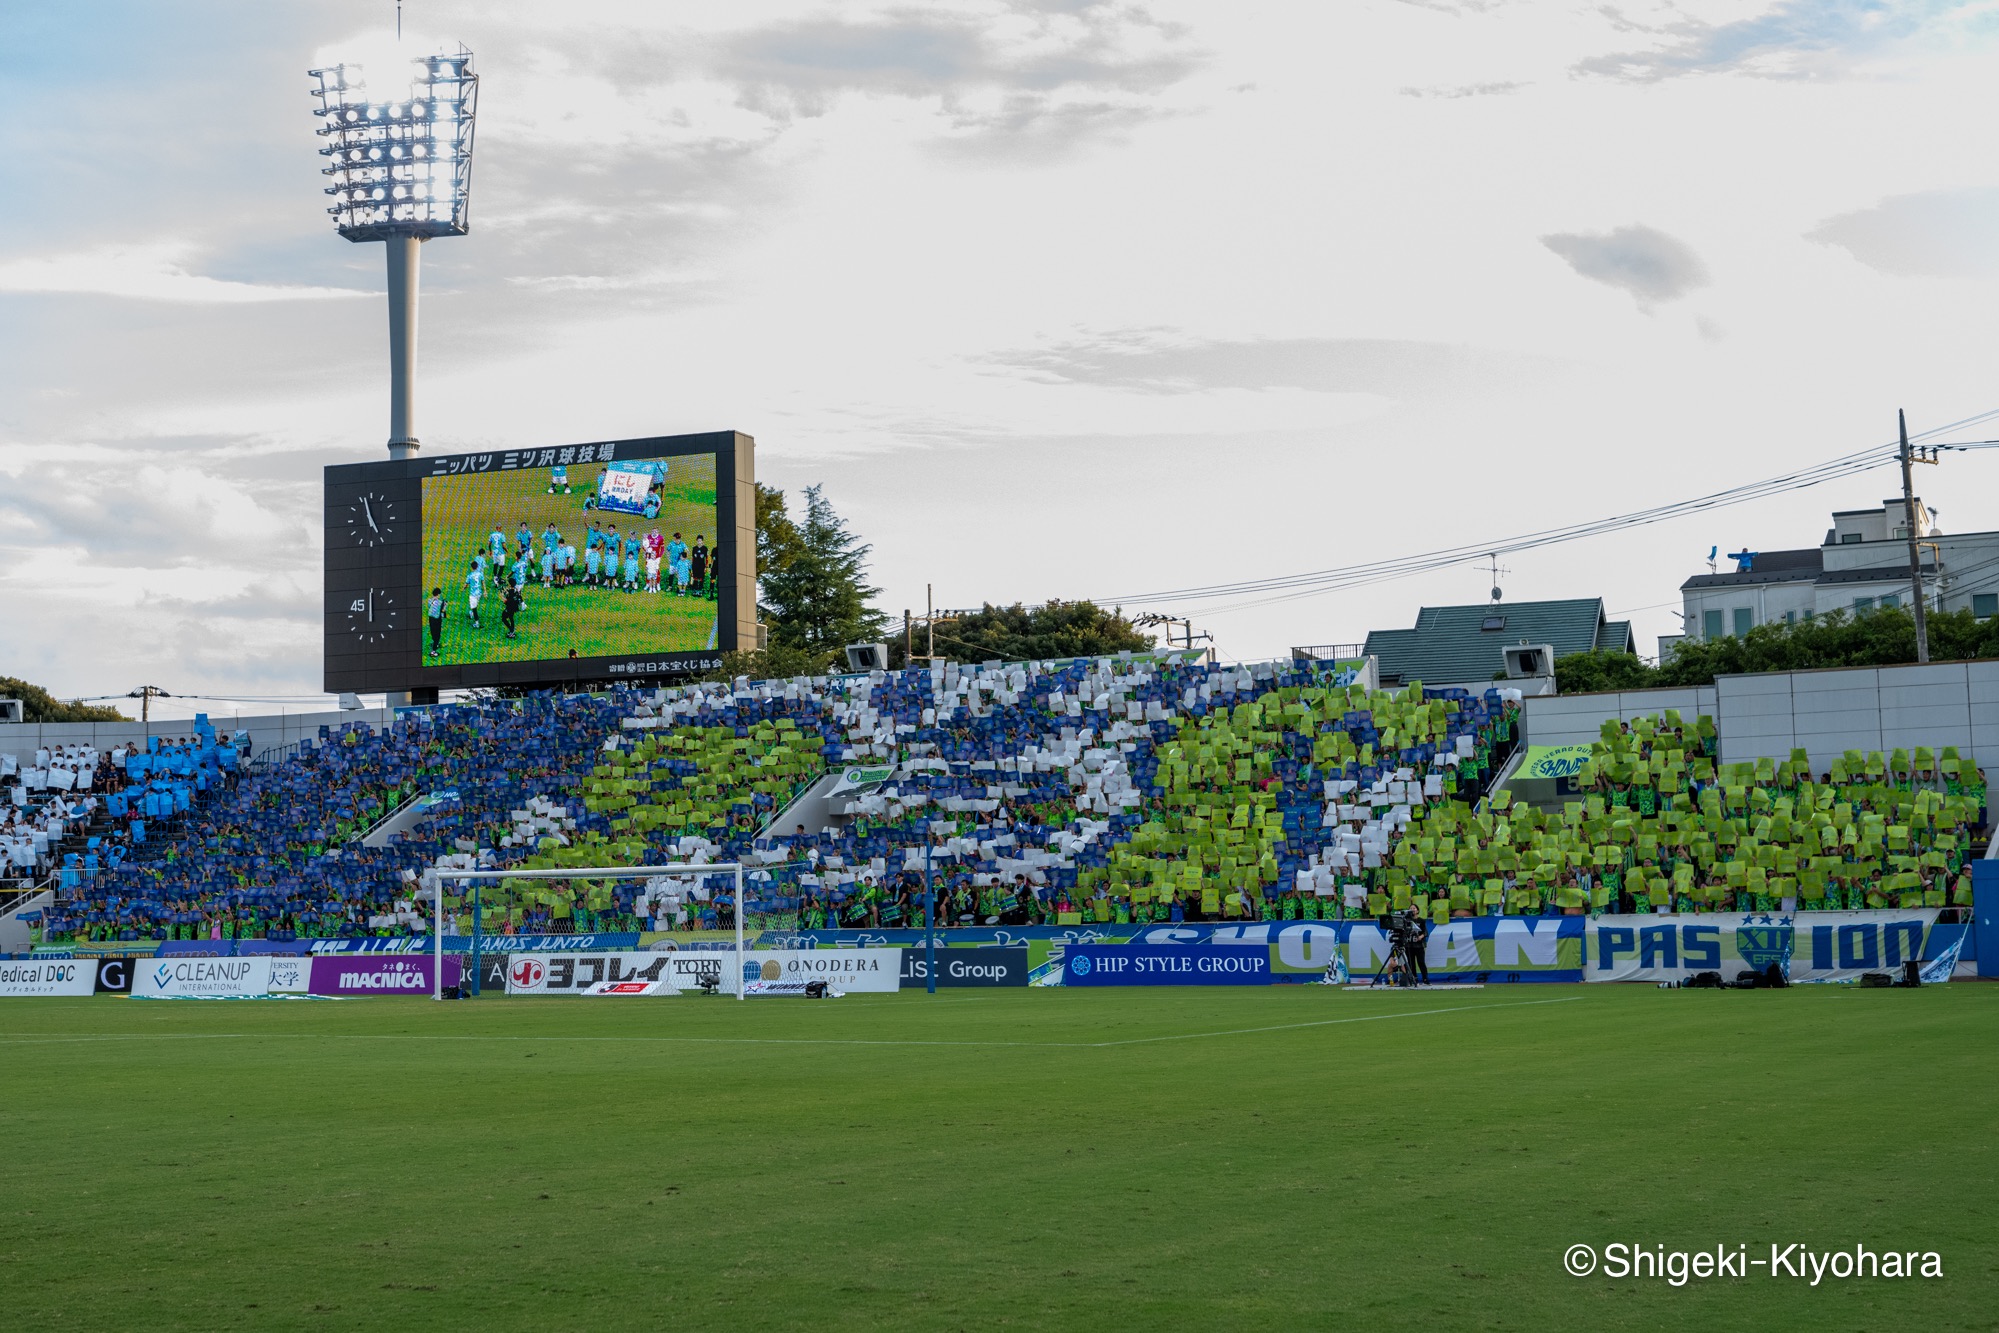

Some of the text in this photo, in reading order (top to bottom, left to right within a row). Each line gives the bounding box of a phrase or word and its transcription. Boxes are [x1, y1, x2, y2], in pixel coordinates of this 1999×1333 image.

[432, 443, 616, 475] ニッパツ 三ツ沢球技場
[350, 599, 365, 612] 45
[646, 658, 723, 672] 日本宝くじ協会
[1539, 756, 1589, 777] SHONA
[46, 964, 76, 983] DOC
[175, 962, 251, 981] CLEANUP
[546, 957, 670, 988] ヨコレイ
[788, 959, 879, 972] ONODERA
[950, 960, 1008, 982] Group
[1095, 957, 1264, 973] HIP STYLE GROUP
[100, 961, 126, 989] G
[269, 971, 299, 986] 大学
[179, 983, 242, 991] INTERNATIONAL
